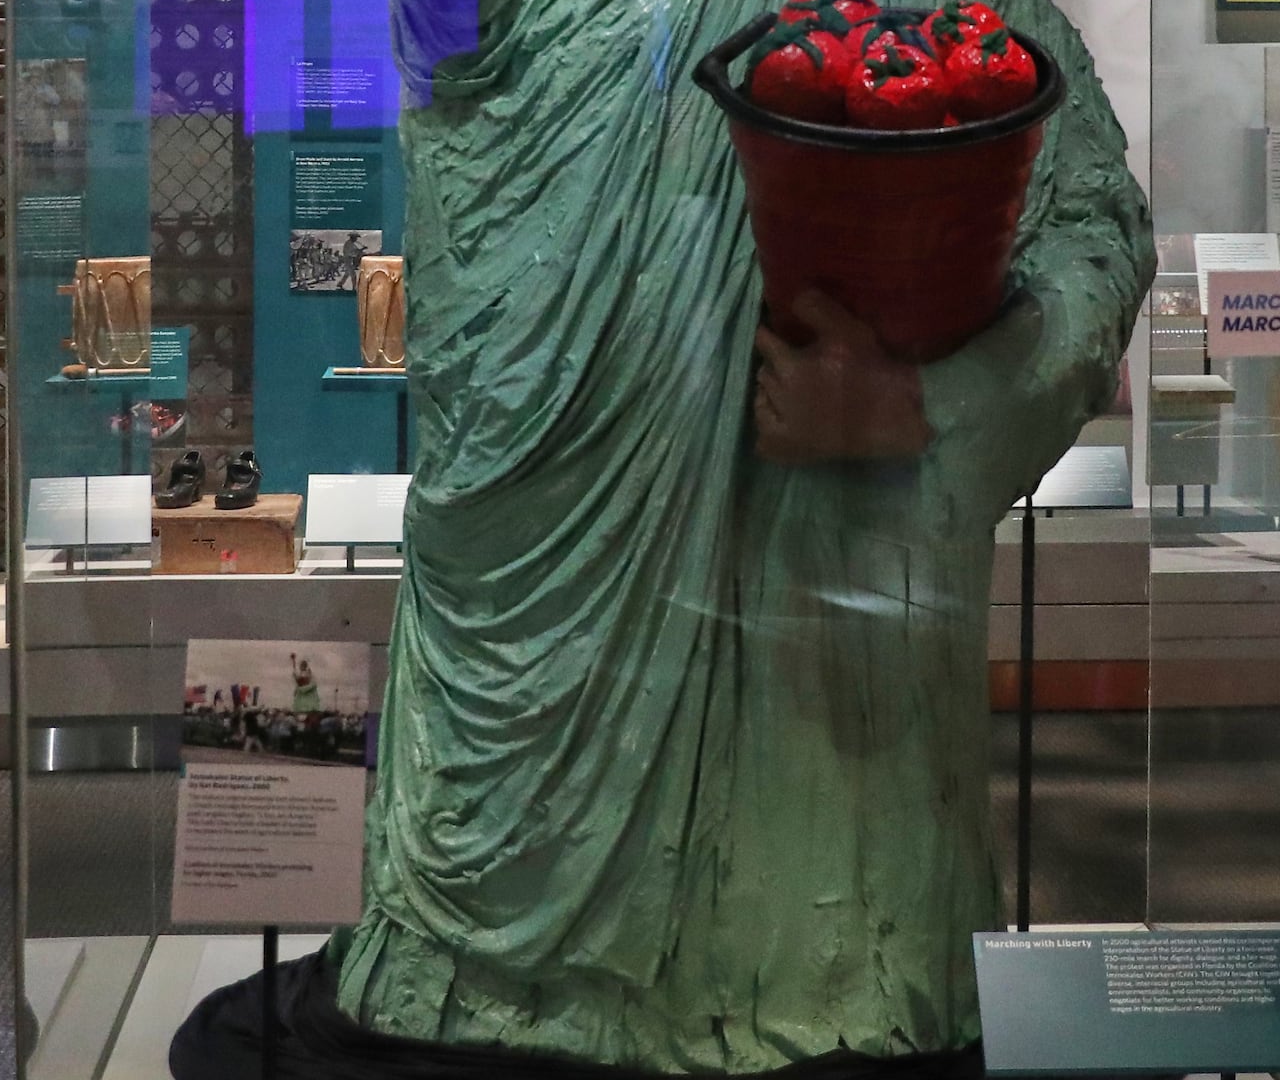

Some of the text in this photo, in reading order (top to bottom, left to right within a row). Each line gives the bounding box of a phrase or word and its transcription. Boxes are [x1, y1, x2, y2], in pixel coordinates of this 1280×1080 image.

[985, 938, 1092, 949] Marching with Liberty
